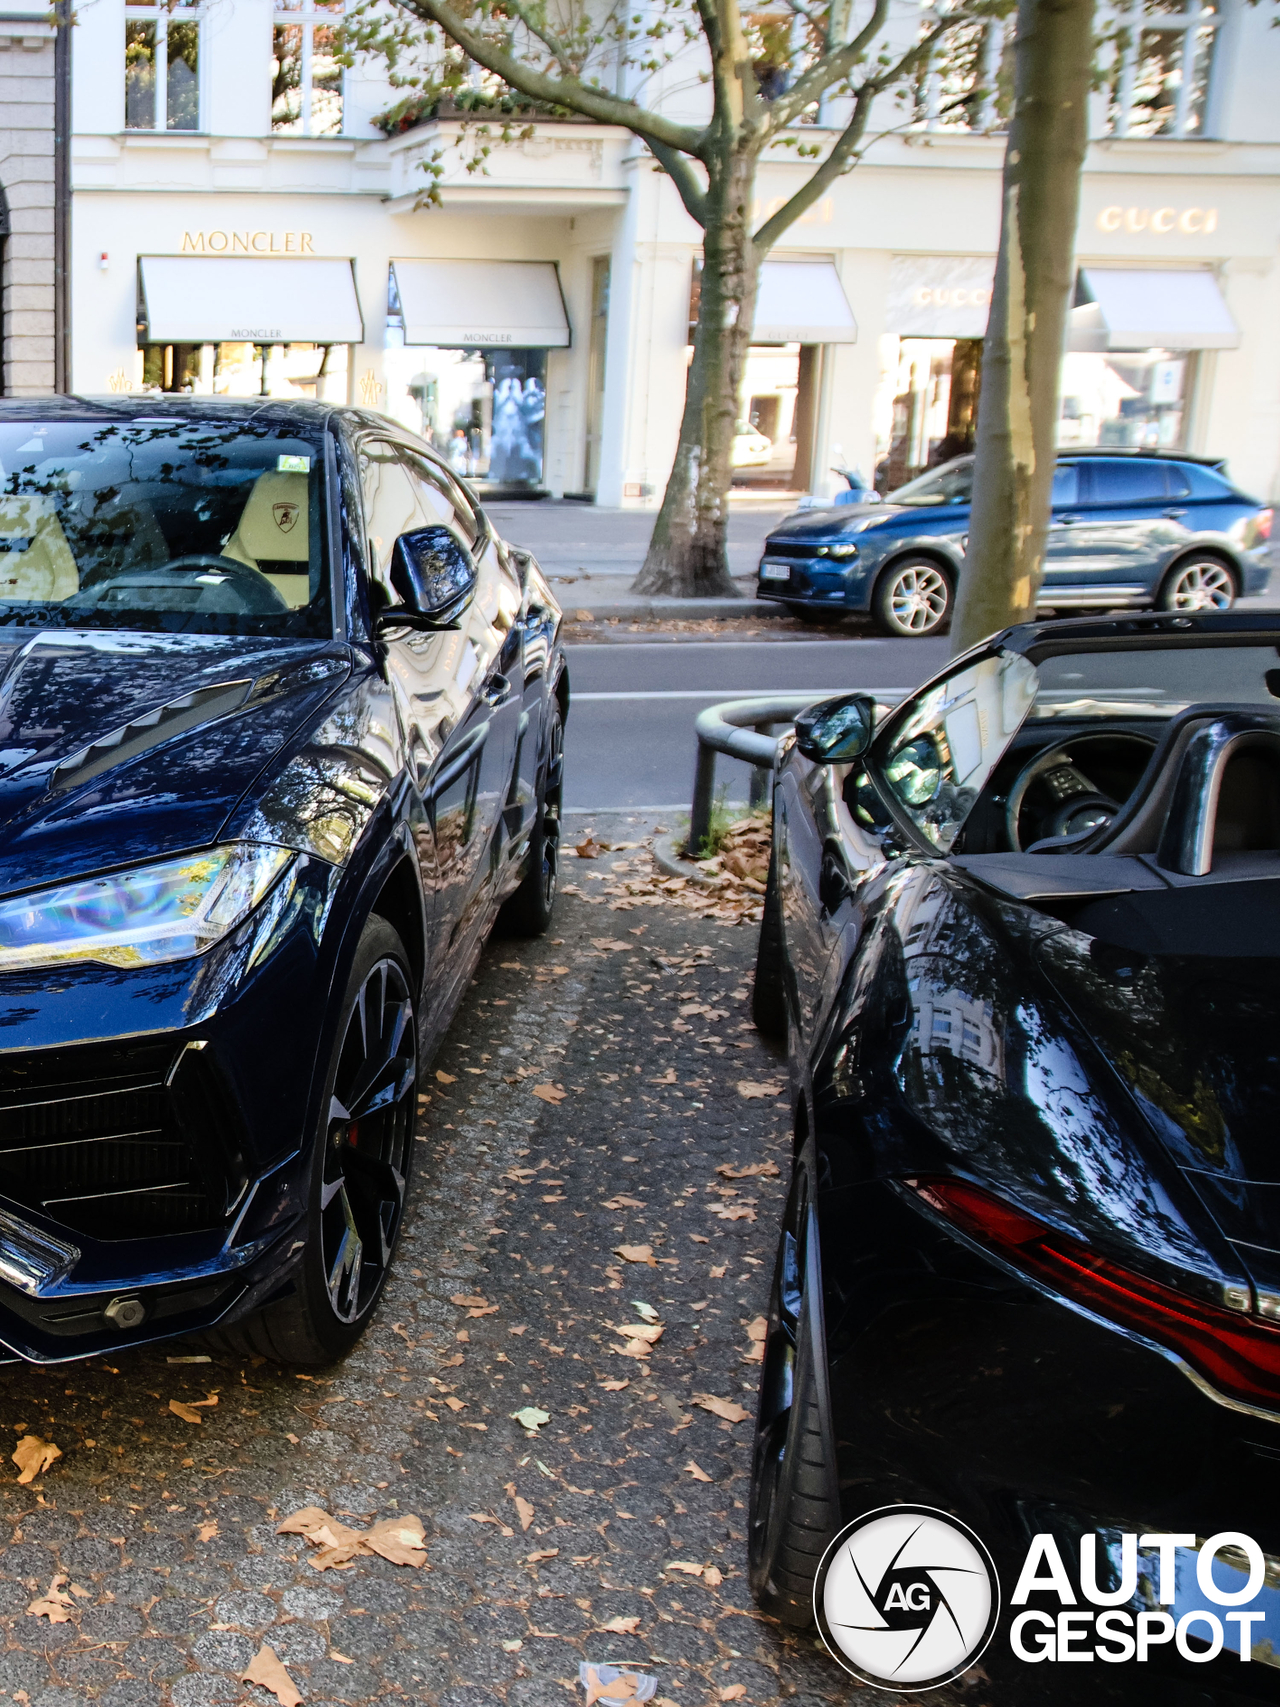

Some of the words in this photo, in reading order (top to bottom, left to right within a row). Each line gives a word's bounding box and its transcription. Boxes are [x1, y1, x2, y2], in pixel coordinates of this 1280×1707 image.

[1096, 205, 1218, 234] GUCCI
[181, 231, 317, 253] MONCLER
[231, 328, 283, 338] MONCLER
[463, 333, 513, 343] MONCLER
